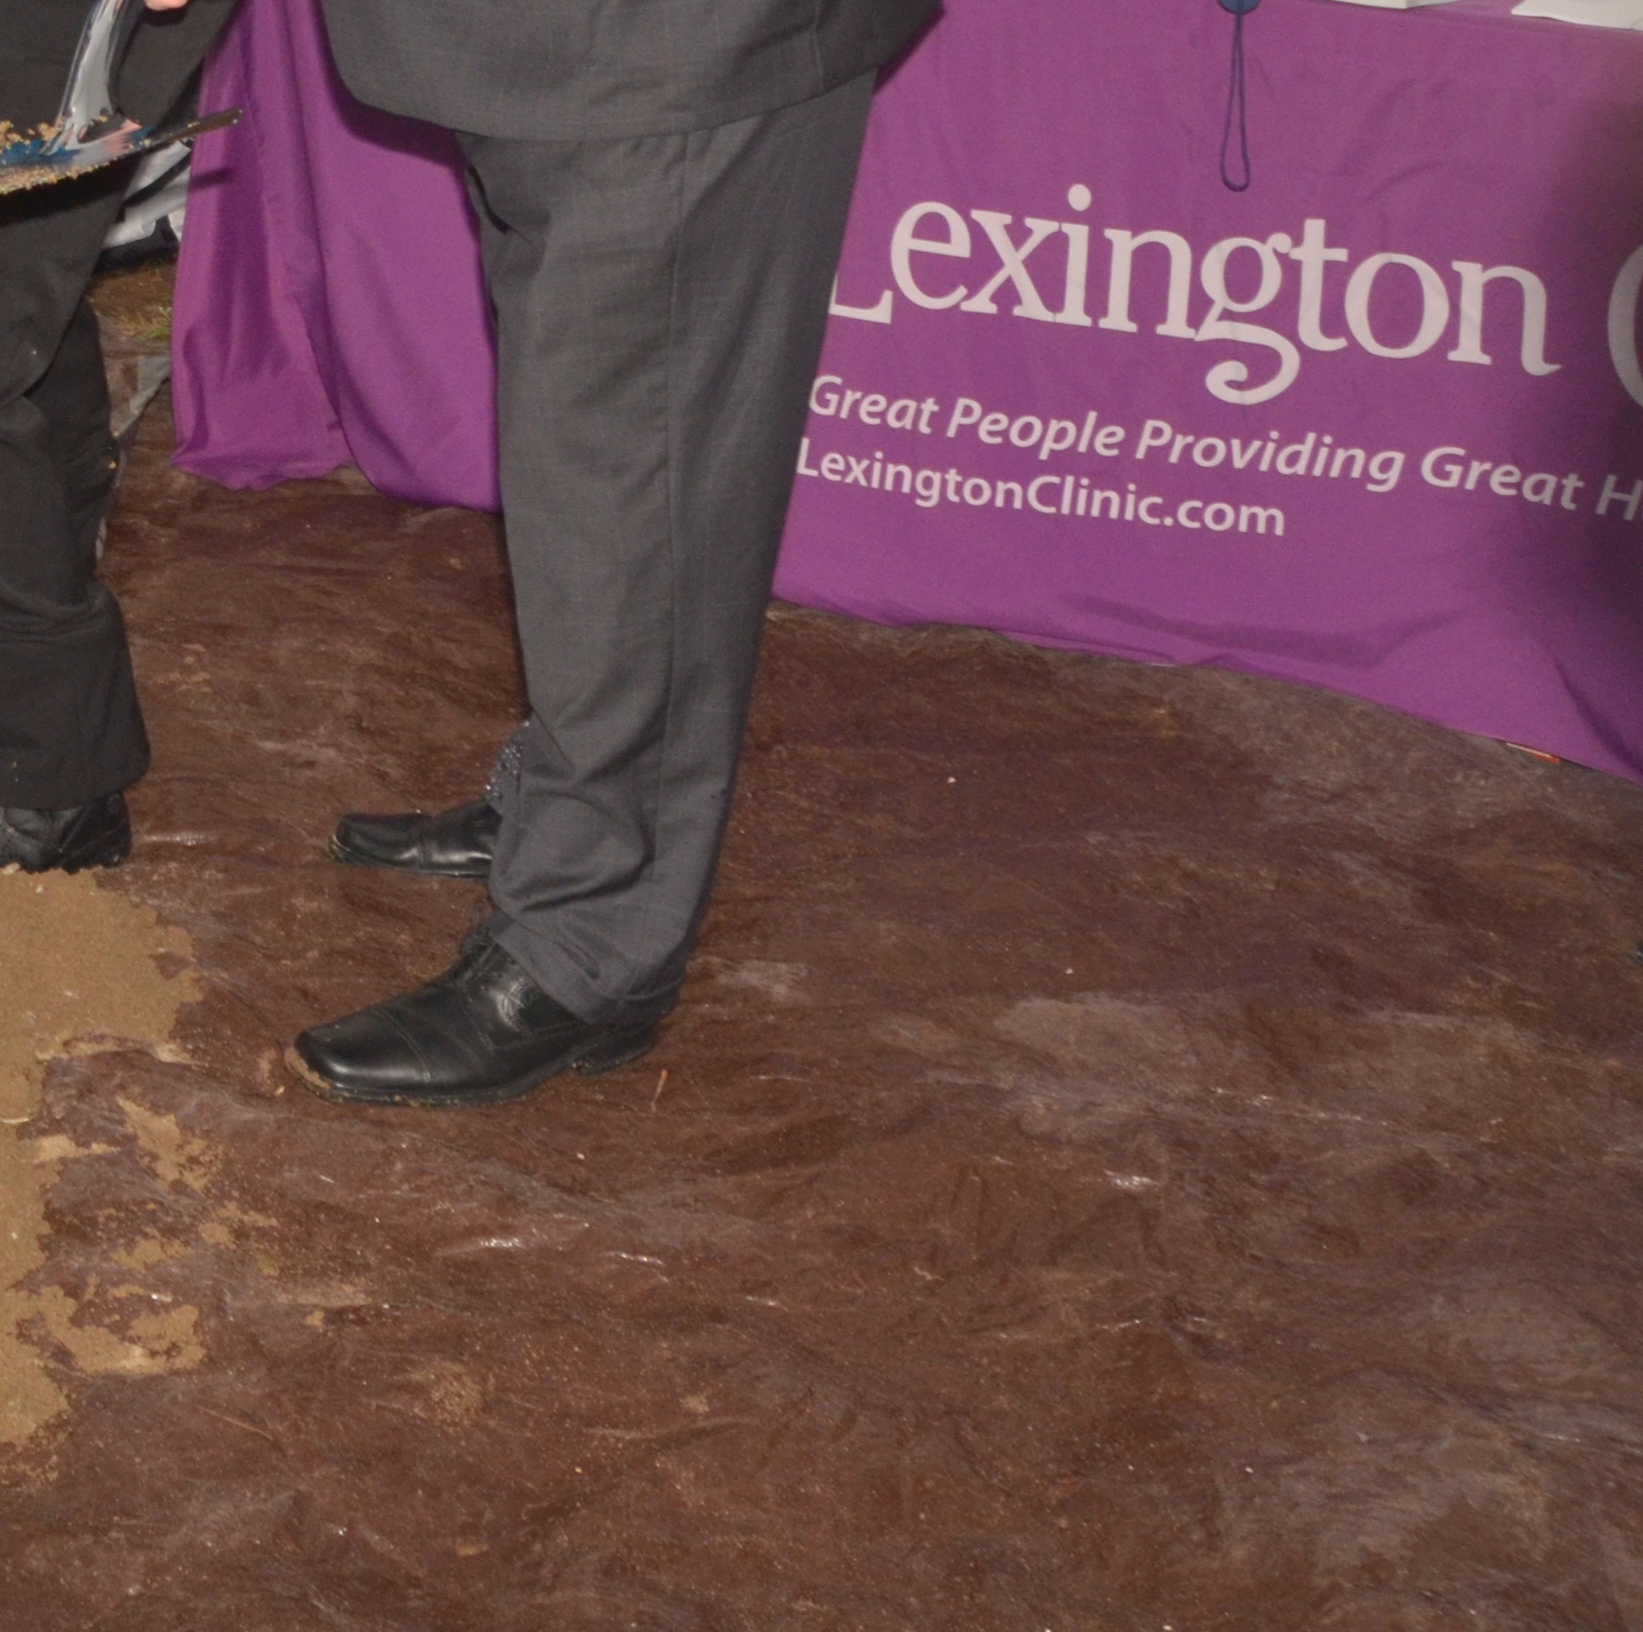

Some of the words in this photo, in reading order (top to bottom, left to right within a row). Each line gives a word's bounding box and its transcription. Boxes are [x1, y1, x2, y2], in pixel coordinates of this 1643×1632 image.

[796, 437, 1286, 536] LexingtonClinic.com
[809, 375, 939, 434] Great
[946, 397, 1126, 460] People
[1135, 419, 1405, 493] Providing
[1421, 446, 1585, 511] Great
[1595, 474, 1643, 522] H
